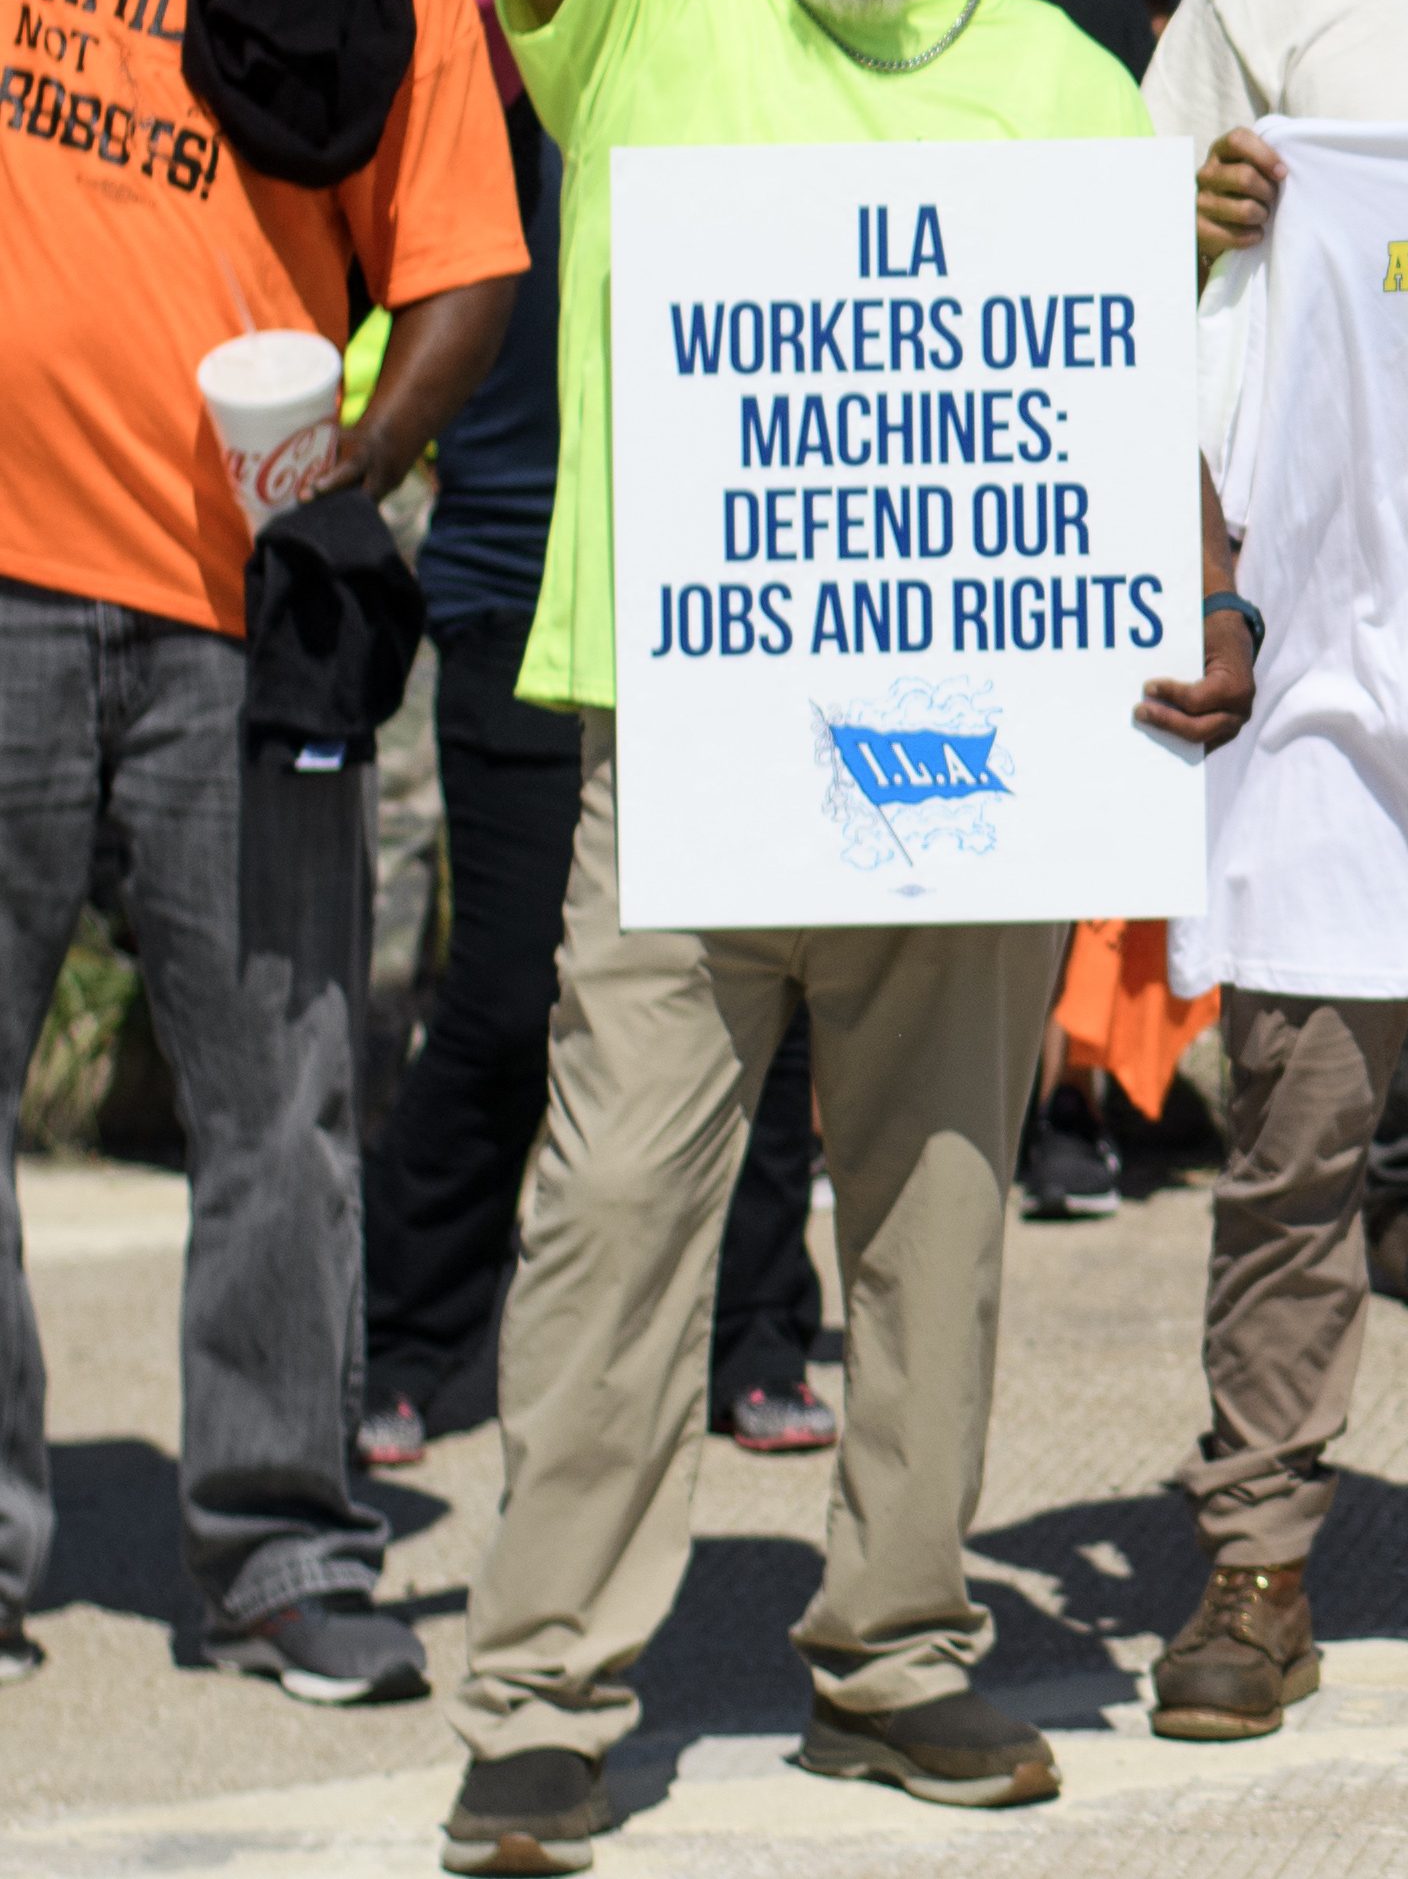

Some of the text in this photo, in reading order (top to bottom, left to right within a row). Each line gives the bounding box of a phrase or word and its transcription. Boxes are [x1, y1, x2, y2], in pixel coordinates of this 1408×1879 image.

[14, 3, 99, 72] NOT
[0, 65, 219, 200] ROBOTS!
[859, 204, 948, 279] ILA
[671, 294, 1136, 375] WORKERS OVER
[740, 389, 1068, 469] MACHINES:
[723, 481, 1090, 562] DEFEND OUR
[652, 573, 1164, 658] JOBS AND RIGHTS
[859, 740, 990, 787] I.L.A.
